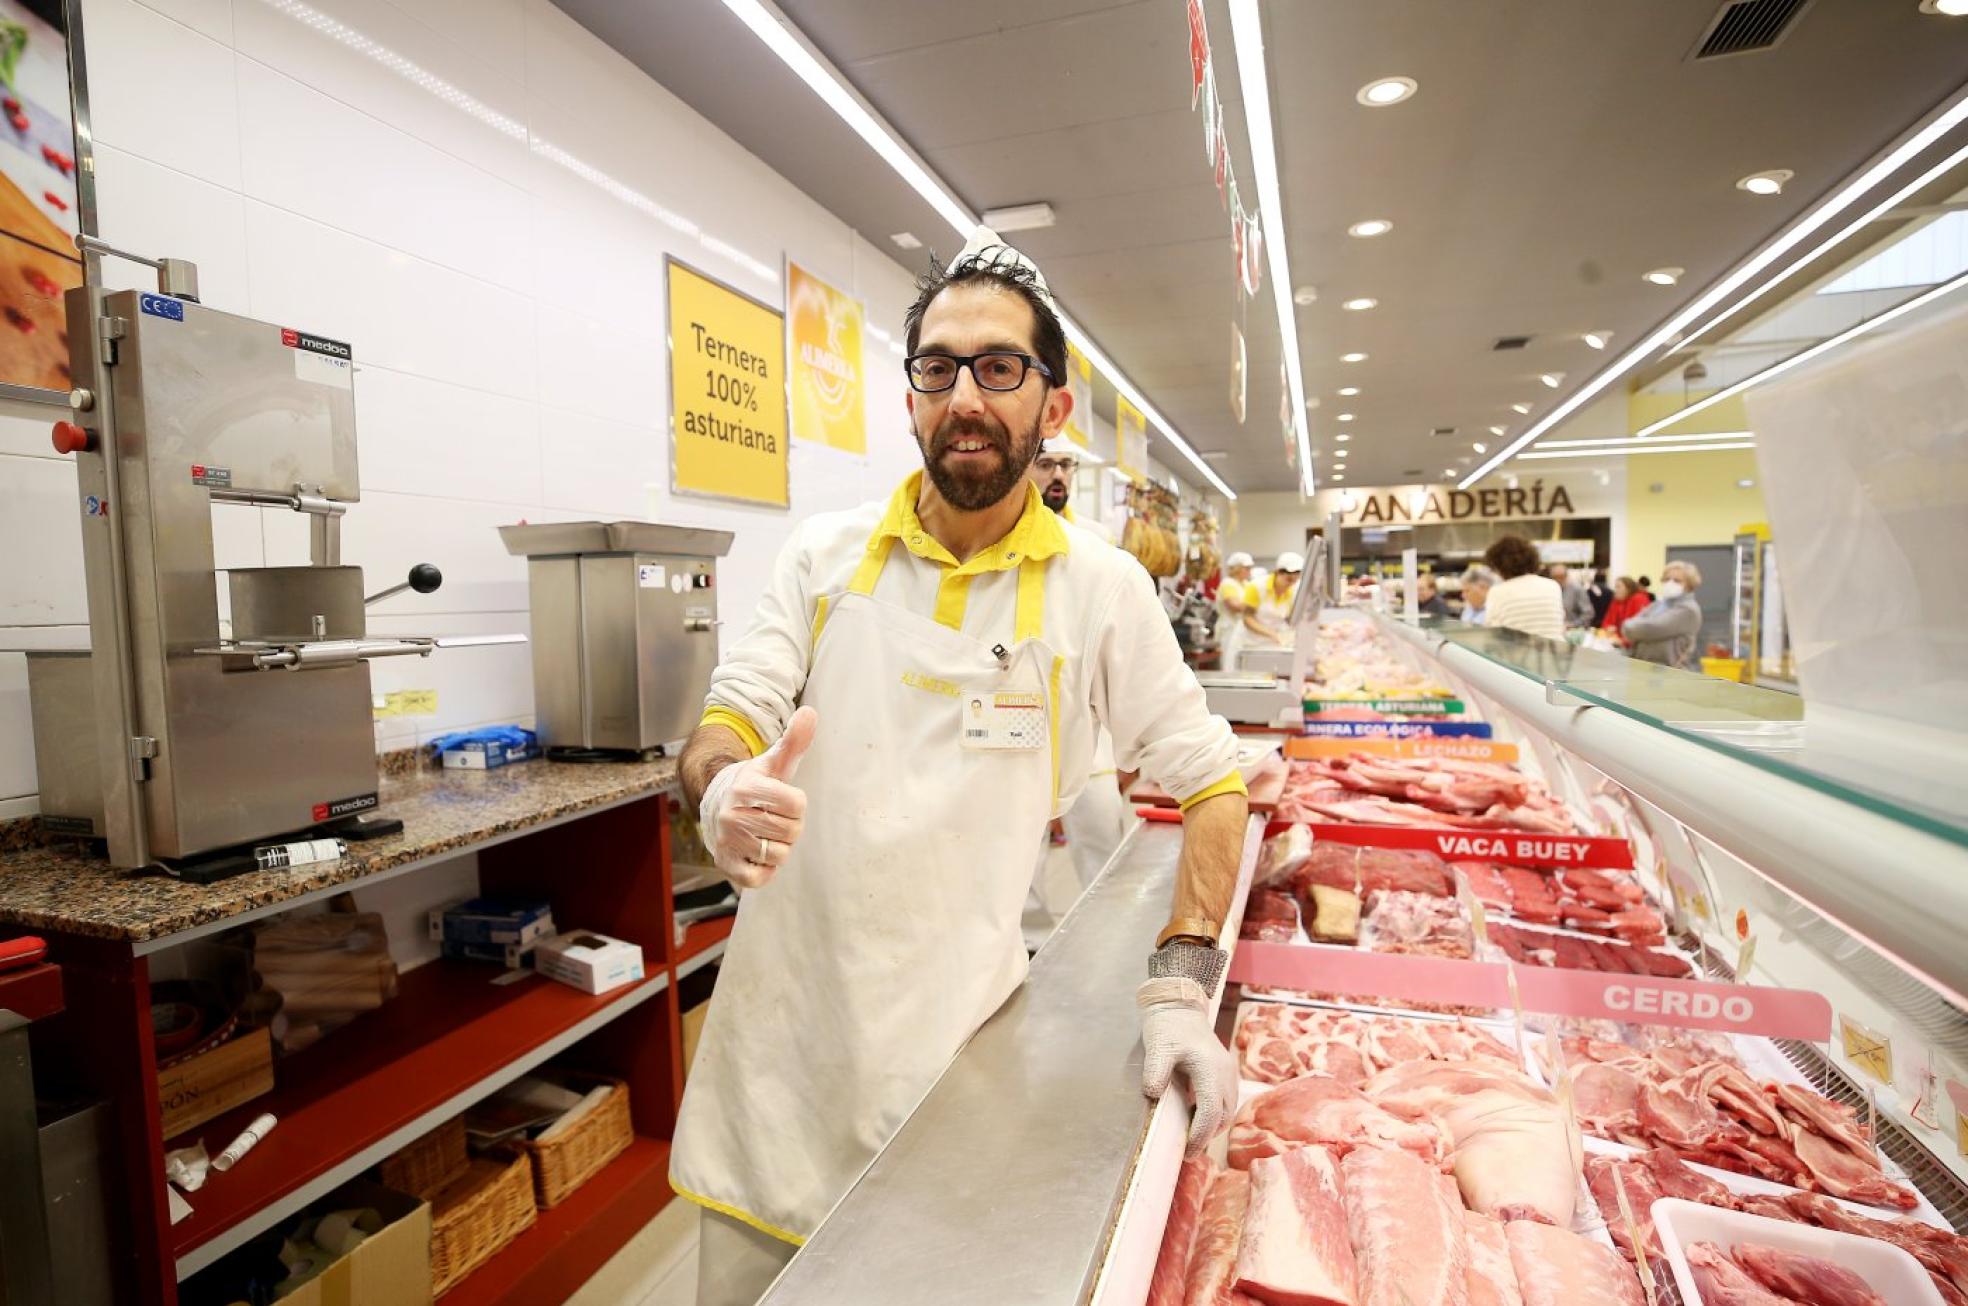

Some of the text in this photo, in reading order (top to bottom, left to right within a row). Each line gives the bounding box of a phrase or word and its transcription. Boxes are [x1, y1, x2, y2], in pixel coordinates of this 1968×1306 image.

[690, 322, 768, 379] Ternera
[706, 370, 758, 412] 100%
[684, 410, 777, 455] asturiana
[1375, 702, 1446, 712] ASTURIANA
[1307, 724, 1352, 736] RNERA
[1414, 743, 1492, 758] LECHAZO
[1437, 836, 1591, 861] VACA BUEY
[1603, 984, 1754, 1022] CERDO
